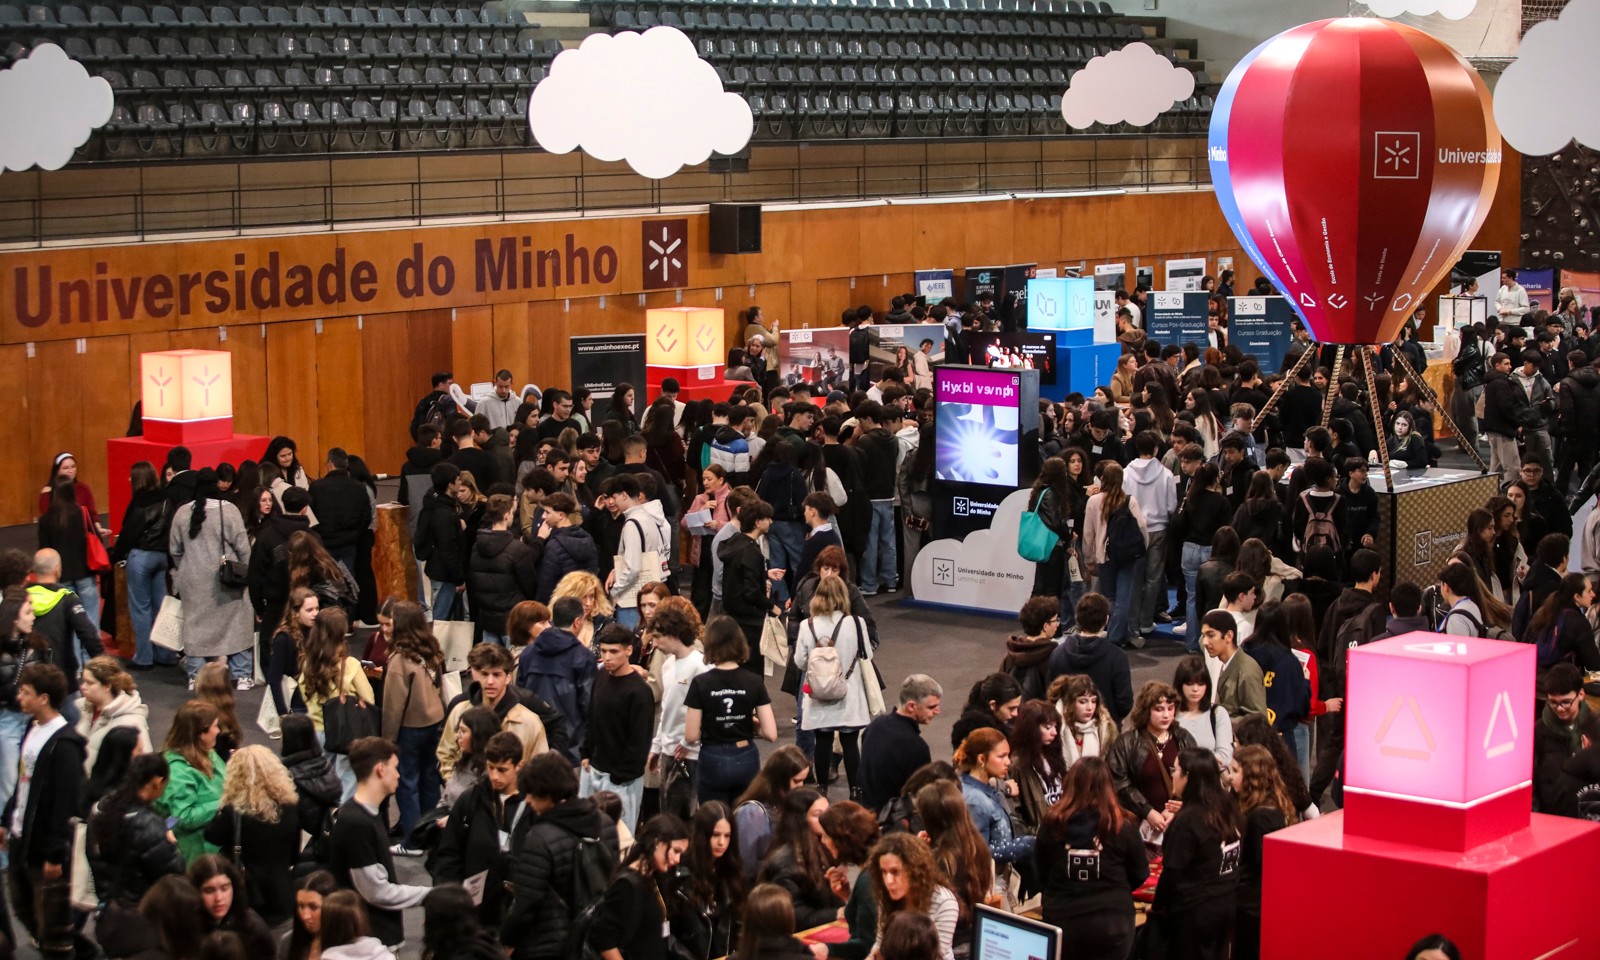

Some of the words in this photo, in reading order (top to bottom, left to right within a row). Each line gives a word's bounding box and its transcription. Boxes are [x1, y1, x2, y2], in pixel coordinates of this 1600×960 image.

[1211, 146, 1227, 162] Minho
[1438, 148, 1497, 164] Universidade
[15, 248, 378, 328] Universidade
[396, 242, 455, 299] do
[475, 234, 618, 293] Minho
[1329, 269, 1337, 284] Escola
[933, 282, 946, 290] IEEE
[970, 501, 999, 509] Universidade
[1433, 533, 1460, 544] Universidade
[958, 567, 995, 577] Universidade
[996, 570, 1005, 578] do
[1006, 571, 1024, 580] Minho
[723, 697, 734, 714] ?
